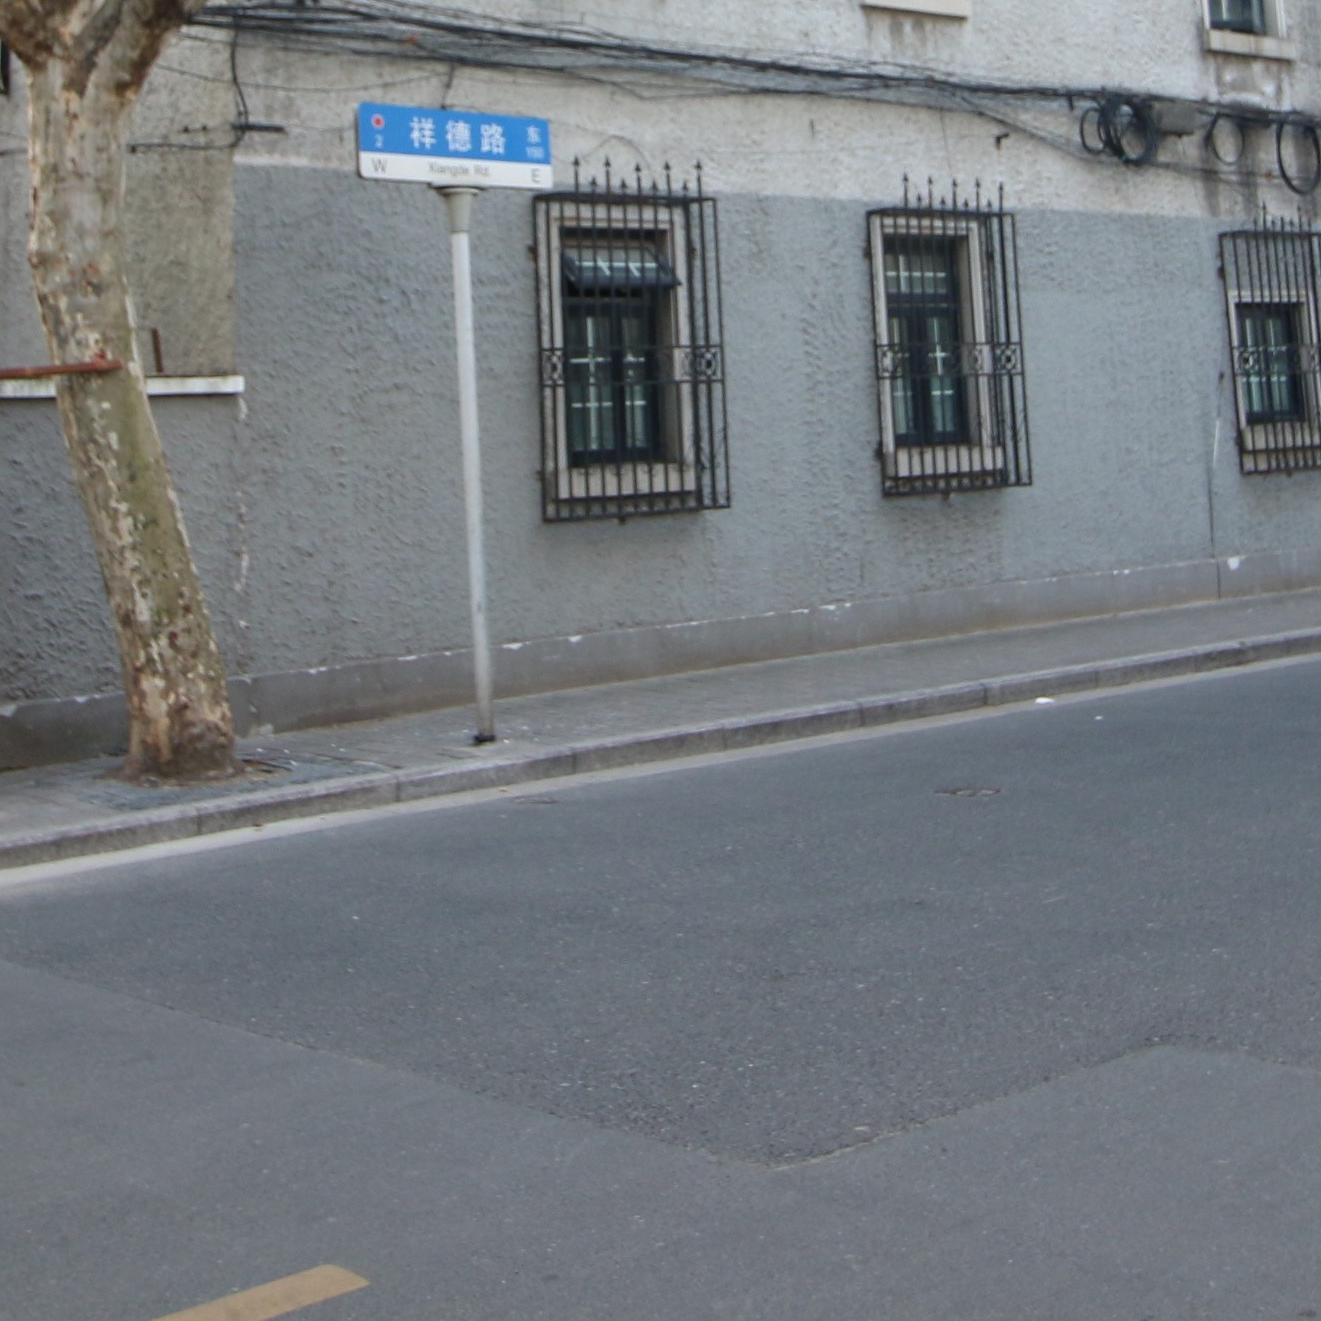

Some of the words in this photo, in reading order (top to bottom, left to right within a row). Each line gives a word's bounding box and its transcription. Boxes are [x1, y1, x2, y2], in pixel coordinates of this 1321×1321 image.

[409, 115, 506, 155] 祥德路
[526, 125, 541, 144] 东
[371, 158, 388, 174] W
[428, 162, 469, 177] Xiangde
[530, 168, 541, 184] E
